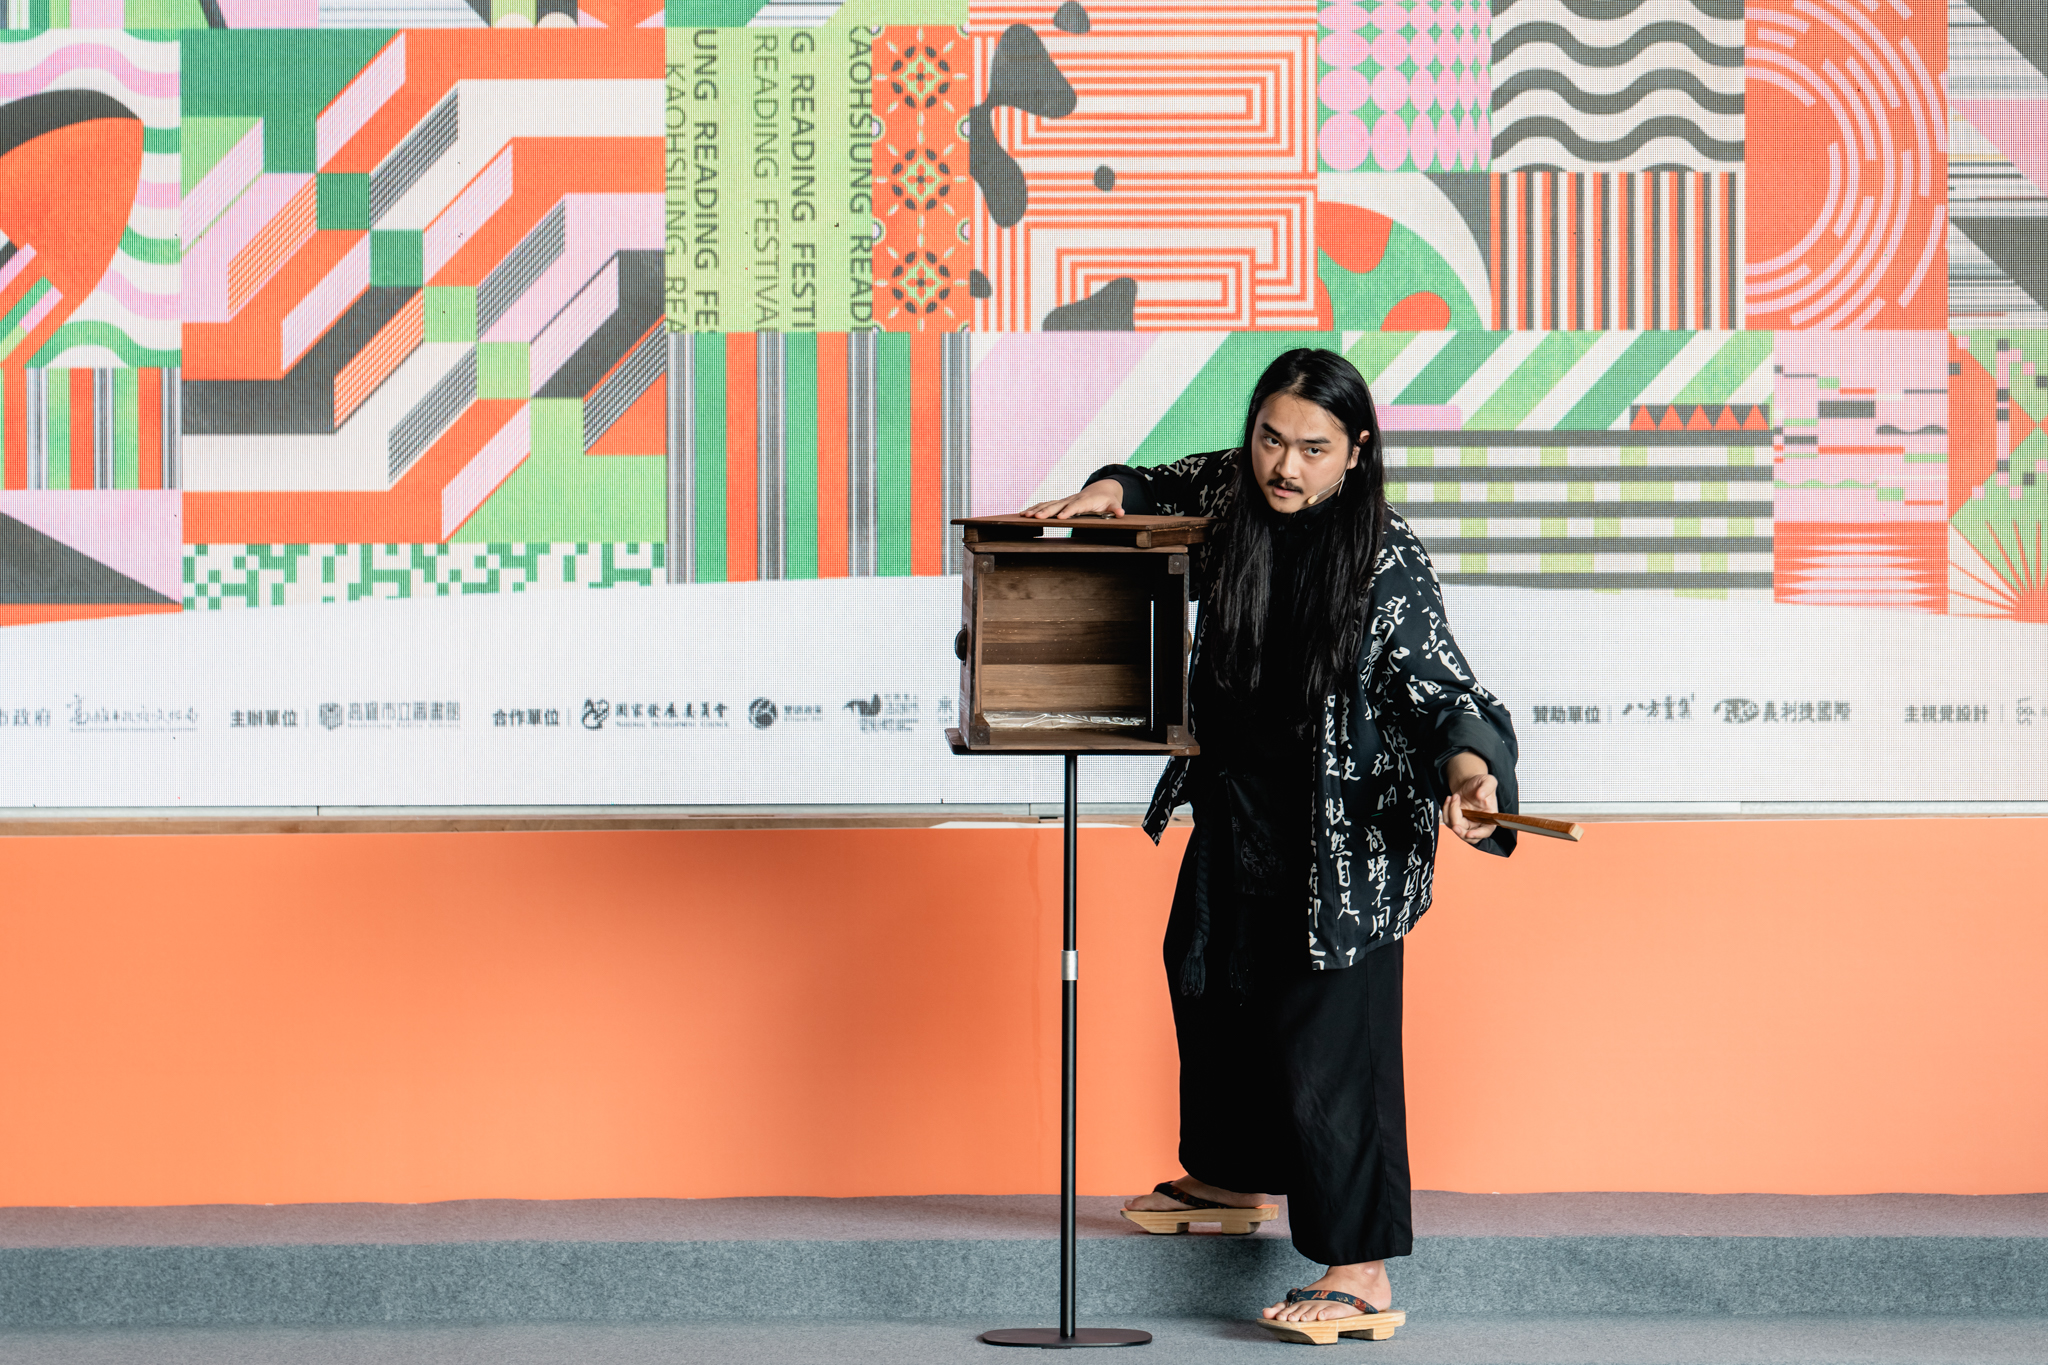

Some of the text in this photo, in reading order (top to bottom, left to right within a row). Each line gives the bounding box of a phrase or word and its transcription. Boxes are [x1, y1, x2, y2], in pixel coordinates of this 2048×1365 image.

[754, 33, 779, 179] READING
[791, 74, 816, 222] READING
[693, 28, 719, 334] UNG READING FE
[792, 242, 816, 328] FESTI
[230, 709, 298, 728] 主辦單位
[493, 709, 560, 728] 合作單位
[1532, 705, 1600, 724] 贊助單位
[1904, 705, 1989, 724] 主視覺設計
